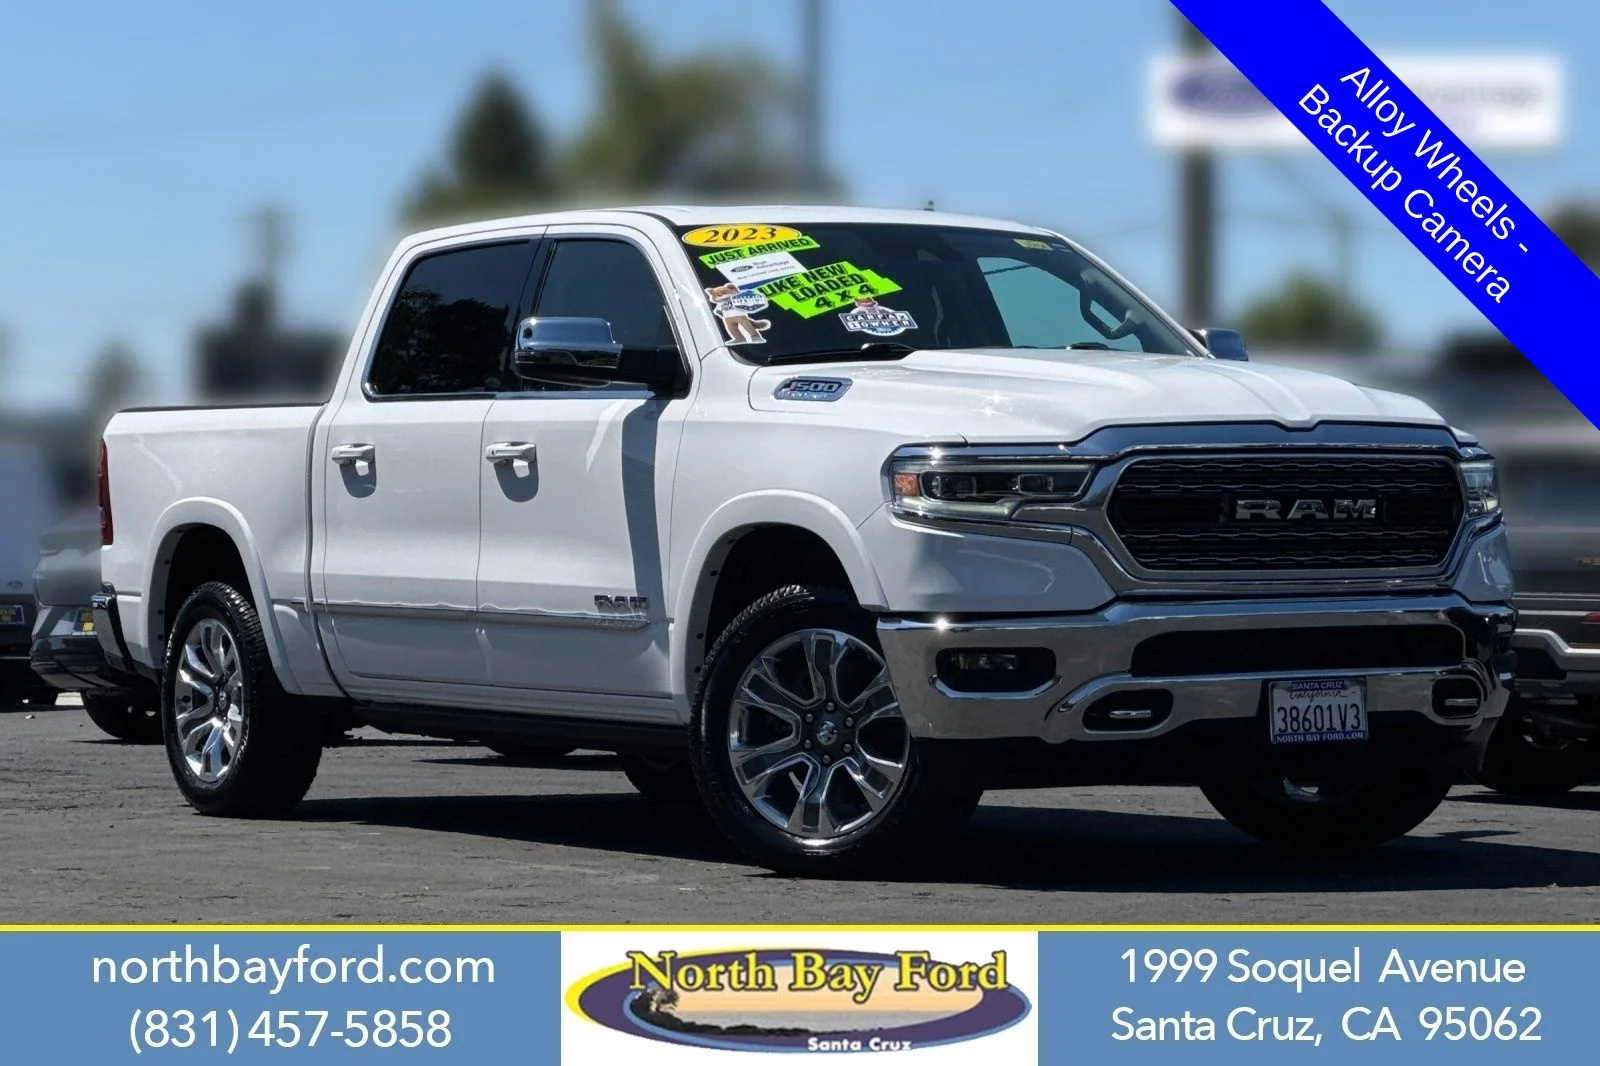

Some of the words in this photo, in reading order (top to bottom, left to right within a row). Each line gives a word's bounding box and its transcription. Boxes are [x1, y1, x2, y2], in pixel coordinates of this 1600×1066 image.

[702, 227, 777, 243] 2023
[707, 249, 745, 265] JUST
[748, 238, 812, 255] ARRIVED
[757, 276, 801, 297] LIKE
[801, 264, 846, 283] NEW
[789, 273, 867, 303] LOADED
[815, 296, 835, 309] 4
[858, 283, 878, 295] 4
[845, 313, 910, 321] CARFAX
[861, 320, 911, 328] OWNER
[789, 381, 839, 392] 1500
[1235, 499, 1377, 519] RAM
[593, 595, 649, 612] RAM
[1292, 682, 1319, 690] SANTA
[1321, 681, 1343, 689] CRUZ
[1289, 690, 1348, 703] California
[1277, 703, 1361, 733] 38601V3
[1276, 735, 1304, 743] NORTH
[1307, 734, 1321, 742] BAY
